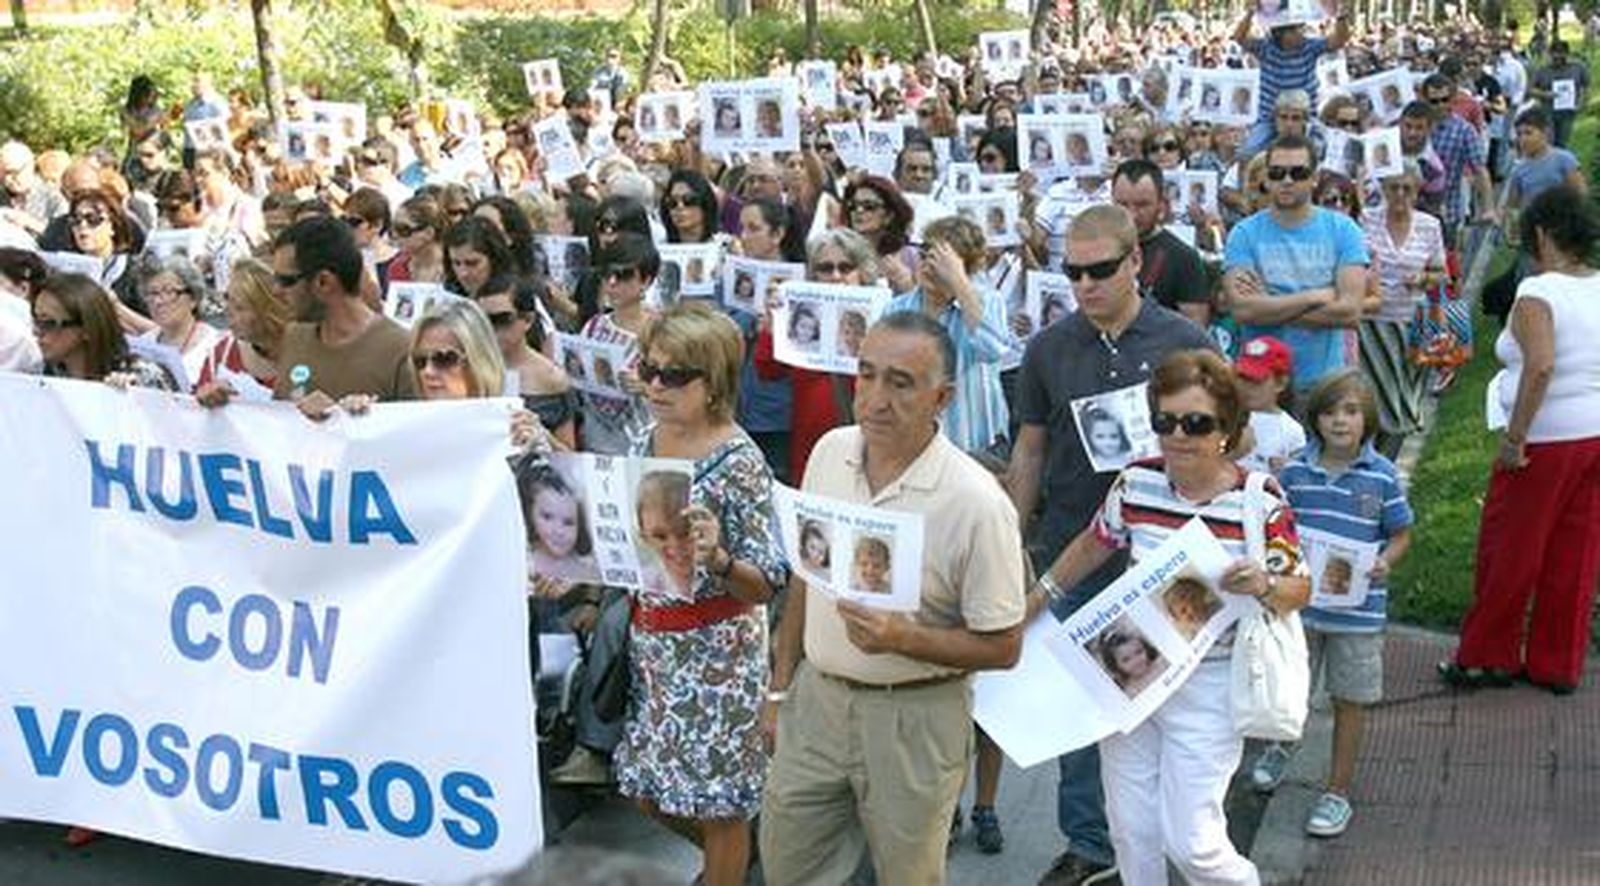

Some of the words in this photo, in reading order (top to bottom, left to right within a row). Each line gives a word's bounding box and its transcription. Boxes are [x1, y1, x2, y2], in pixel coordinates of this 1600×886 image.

[85, 440, 419, 546] HUELVA
[170, 586, 340, 685] CON
[1067, 603, 1122, 646] Huelva
[14, 705, 499, 851] VOSOTROS
